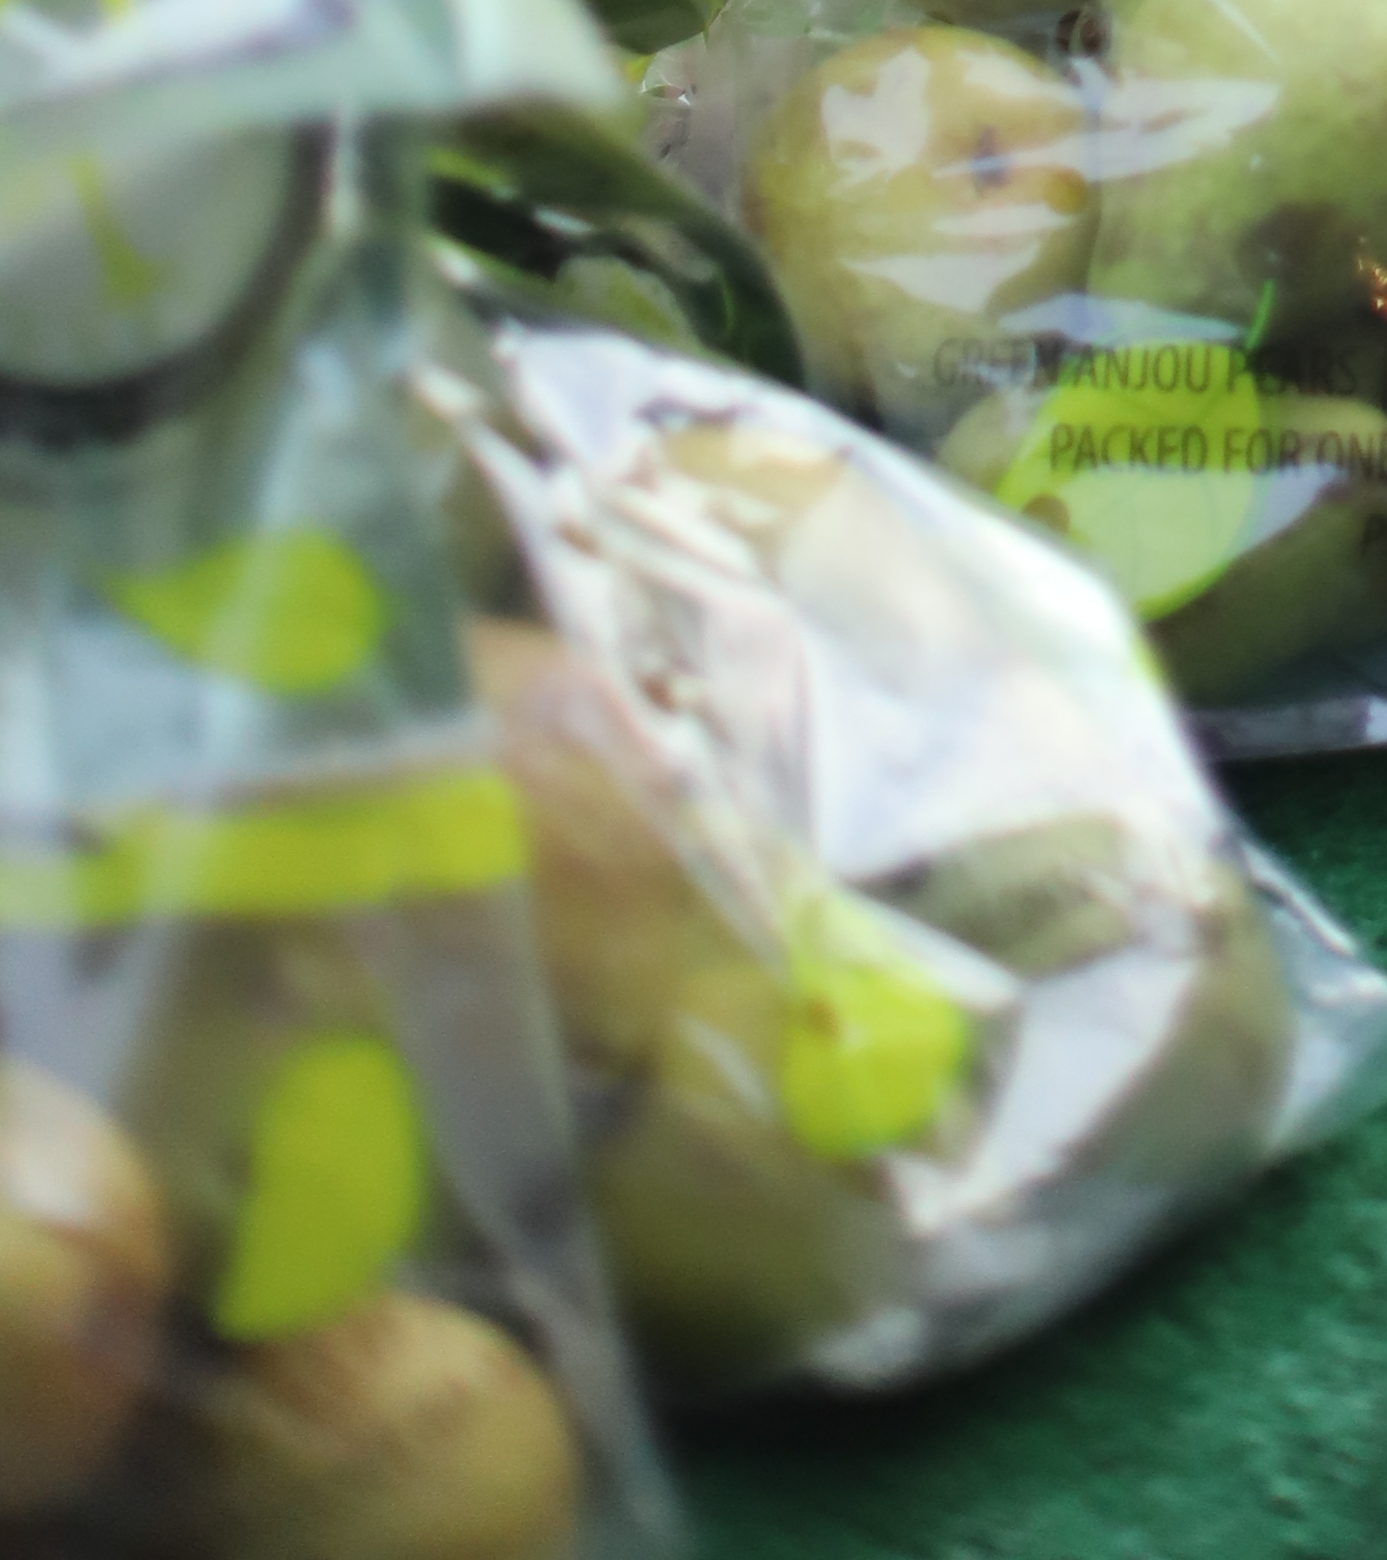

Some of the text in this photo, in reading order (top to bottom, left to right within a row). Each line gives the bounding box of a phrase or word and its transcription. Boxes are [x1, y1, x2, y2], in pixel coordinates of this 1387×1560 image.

[1073, 338, 1214, 395] ANJOU
[1050, 421, 1207, 476] PACKED
[1221, 425, 1303, 477] FOR
